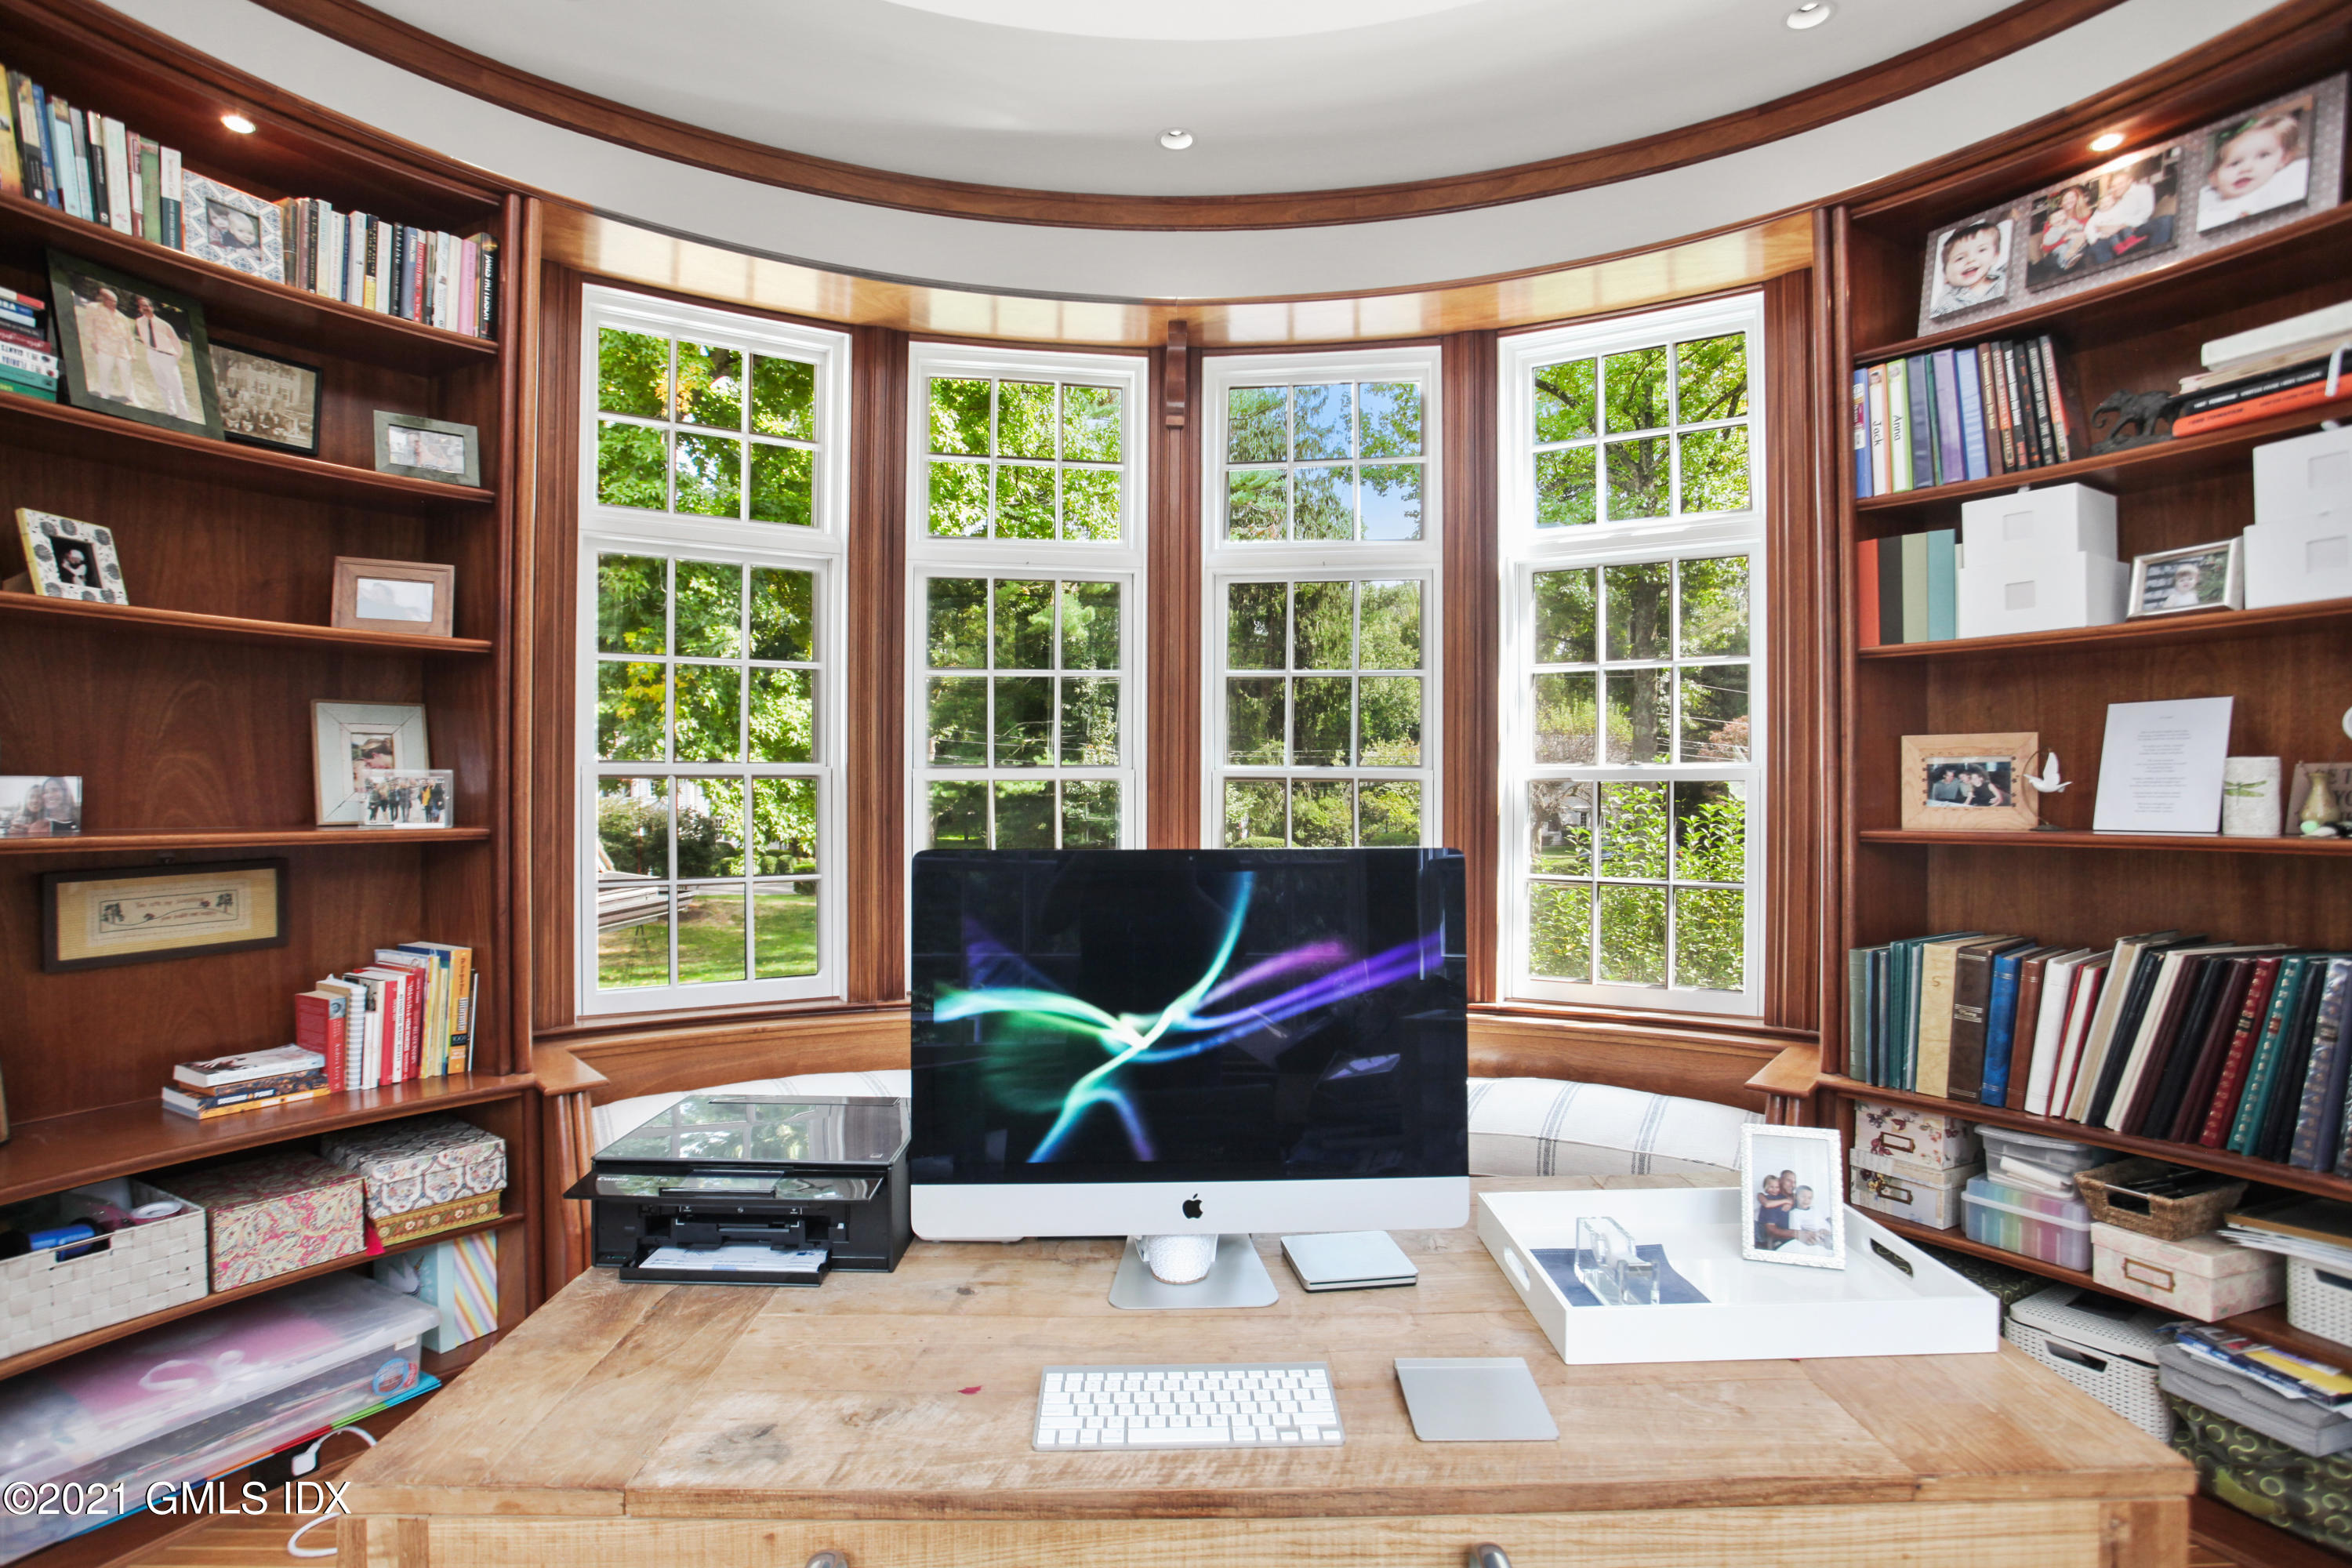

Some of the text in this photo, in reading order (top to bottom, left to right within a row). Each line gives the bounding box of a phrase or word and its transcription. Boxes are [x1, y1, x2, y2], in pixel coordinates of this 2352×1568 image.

[394, 223, 403, 263] EVENING
[483, 254, 492, 321] JAMES PATTERSON
[2028, 347, 2041, 373] GREENWICH
[2032, 372, 2043, 392] COUNTRY
[2034, 390, 2045, 401] DAY
[2035, 400, 2047, 418] SCHOOL
[1872, 420, 1884, 446] Jack
[1893, 415, 1903, 441] Anna
